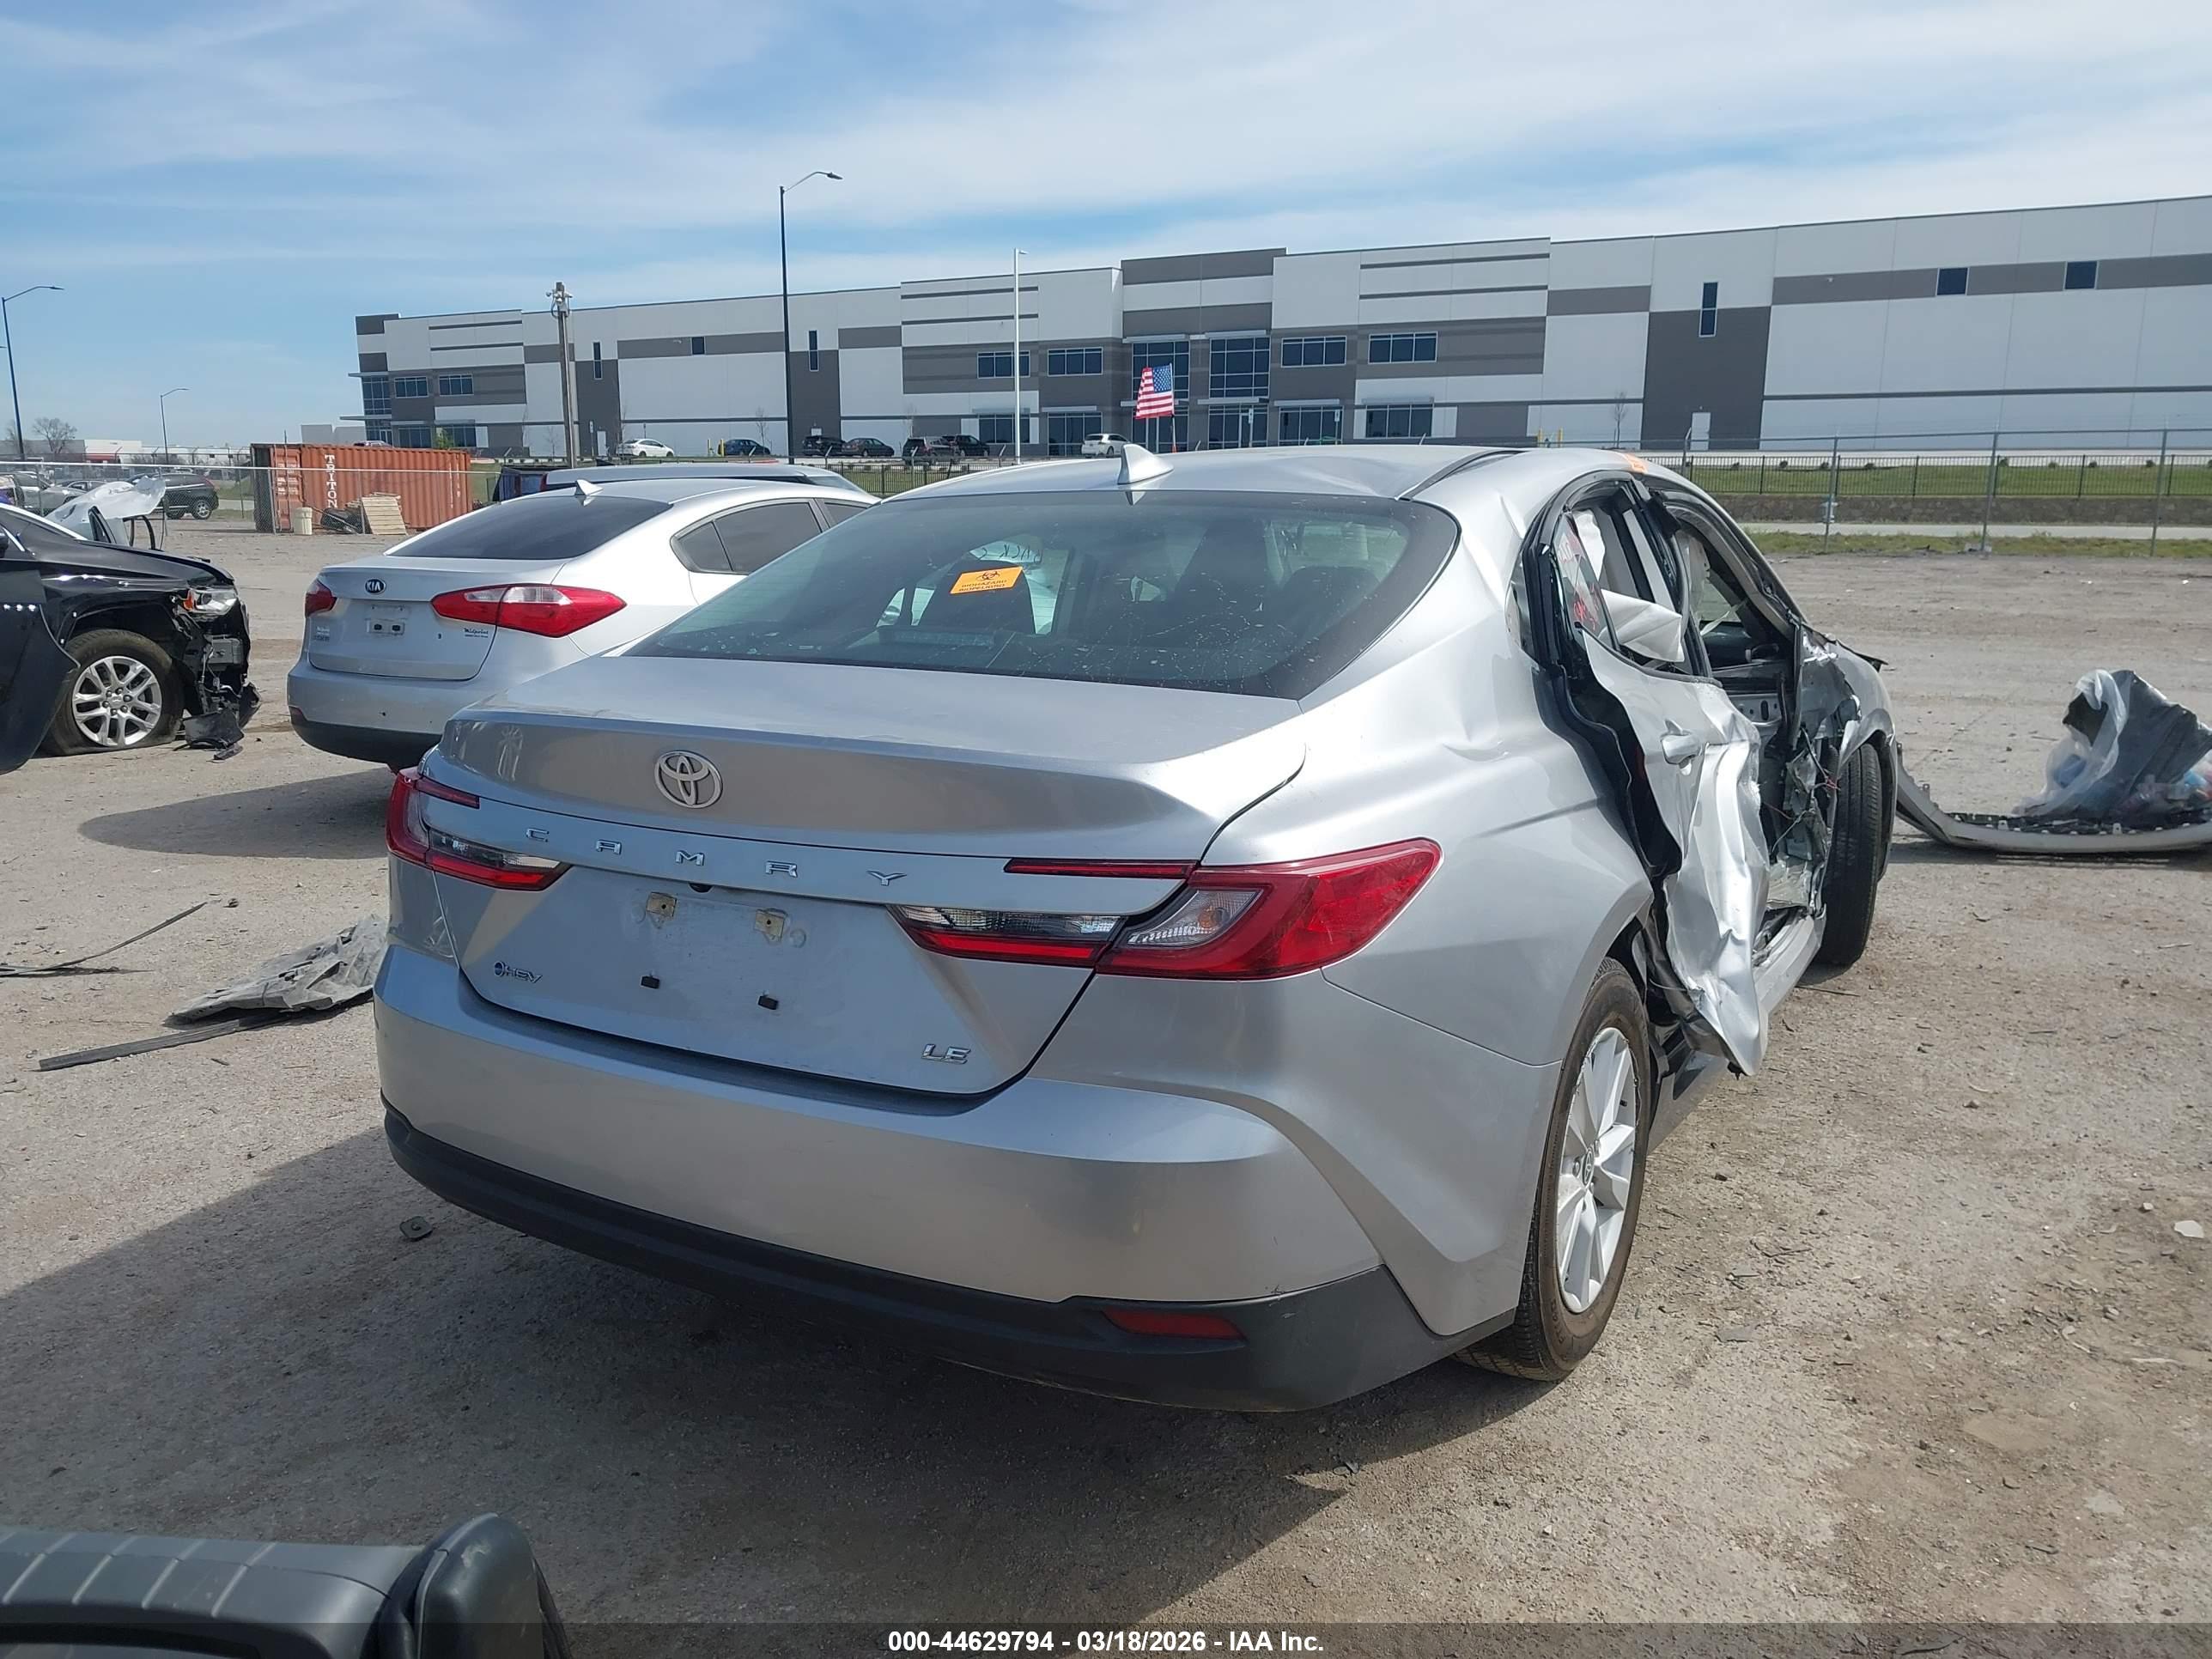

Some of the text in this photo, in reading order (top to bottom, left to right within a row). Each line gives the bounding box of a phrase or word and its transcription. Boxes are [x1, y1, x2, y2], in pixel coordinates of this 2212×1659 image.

[324, 454, 337, 507] TRITON
[367, 581, 381, 592] KIA
[526, 828, 907, 886] CAMRY
[505, 966, 543, 983] HEV
[921, 1044, 971, 1064] LE
